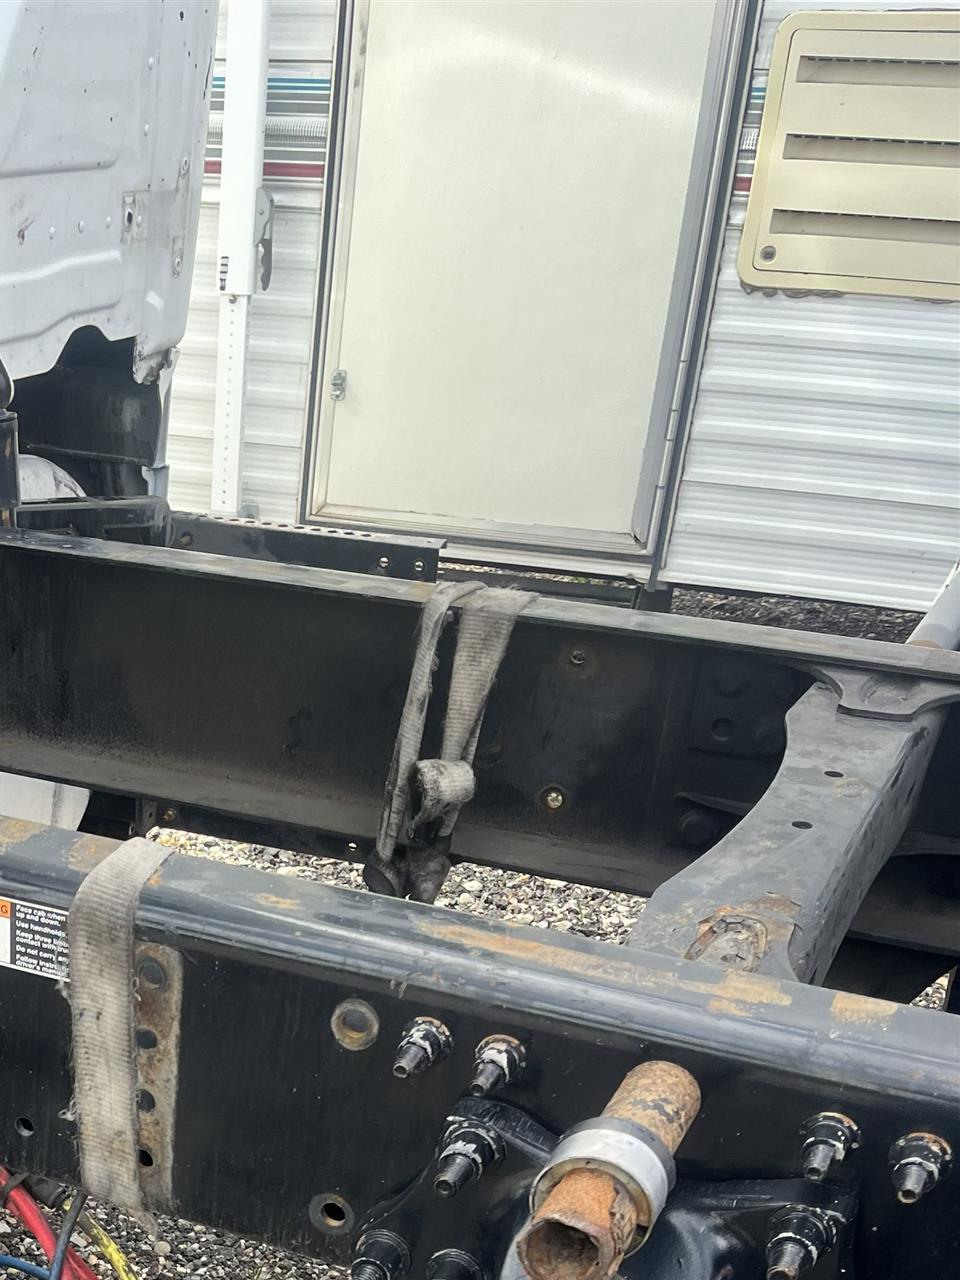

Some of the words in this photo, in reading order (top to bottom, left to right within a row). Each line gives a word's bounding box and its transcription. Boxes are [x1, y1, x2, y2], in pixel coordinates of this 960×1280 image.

[16, 905, 32, 914] Face
[16, 920, 29, 928] Use
[40, 917, 61, 927] down.
[16, 930, 33, 940] Keep
[34, 934, 52, 944] three
[16, 937, 41, 947] contact
[42, 942, 57, 951] with
[16, 945, 26, 953] Do
[26, 948, 38, 956] not
[16, 954, 38, 964] Follow
